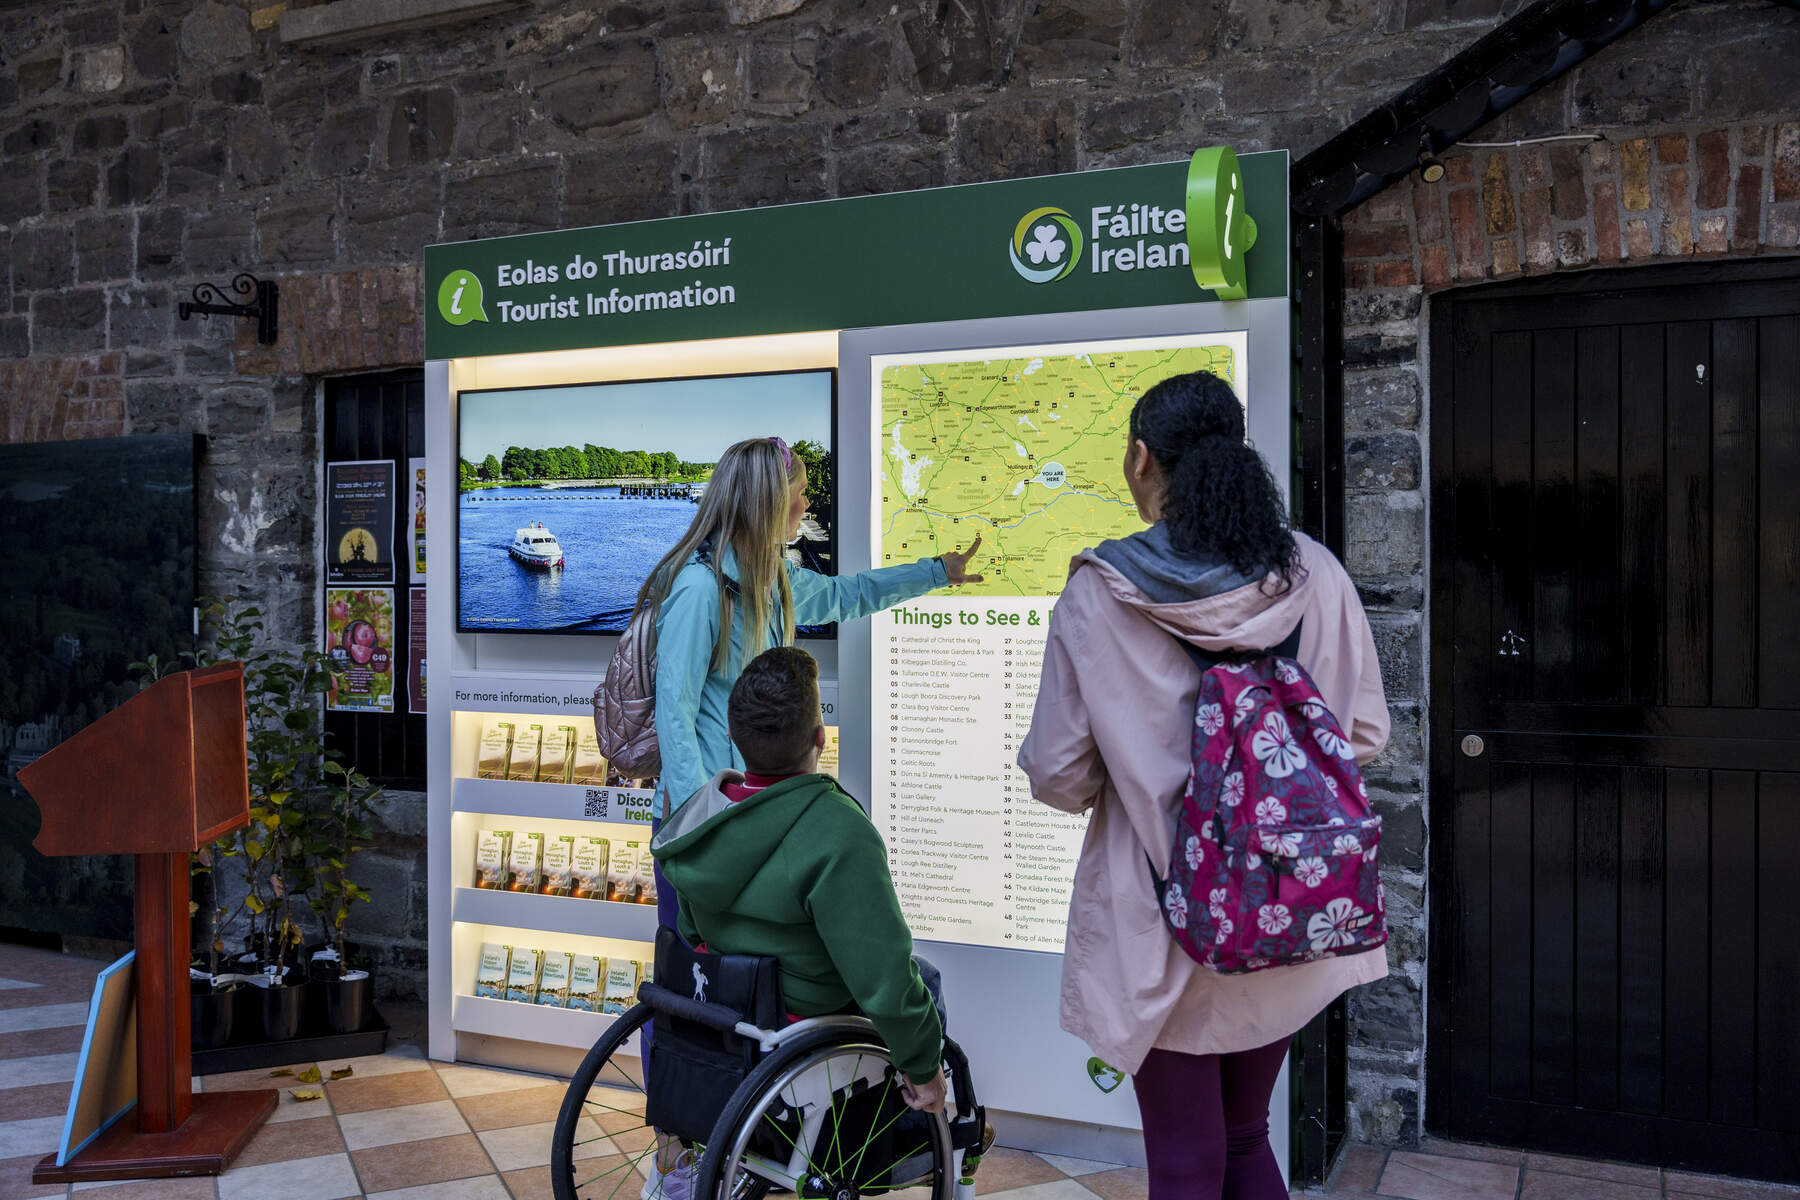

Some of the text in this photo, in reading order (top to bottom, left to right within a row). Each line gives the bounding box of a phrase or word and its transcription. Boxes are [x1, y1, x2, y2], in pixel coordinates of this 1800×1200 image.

[1091, 202, 1186, 239] Fáilte
[1091, 239, 1190, 273] Irelan
[497, 238, 732, 287] Eolas do Thurasóirí
[497, 280, 736, 323] Tourist Information
[891, 607, 1040, 629] Things to See &
[967, 637, 981, 645] King
[455, 690, 594, 707] For more information, please
[901, 692, 919, 700] Lough
[938, 693, 967, 701] Discovery
[901, 725, 924, 734] Clonony
[925, 726, 944, 734] Castle
[901, 737, 945, 745] Shannonbridge
[616, 793, 653, 807] Disco
[915, 793, 936, 802] Gallery
[624, 808, 653, 821] Irela
[949, 807, 974, 815] Heritage
[1028, 809, 1048, 817] Round
[918, 816, 944, 824] Uisneach
[1015, 820, 1050, 828] Castletown
[1051, 822, 1070, 830] House
[1015, 831, 1035, 840] Leixlip
[1035, 832, 1055, 840] Castle
[1015, 842, 1045, 851] Maynooth
[1046, 844, 1066, 852] Castle
[921, 850, 948, 859] Trackway
[901, 860, 919, 868] Lough
[932, 862, 957, 871] Distillery
[1015, 861, 1061, 871] Walled Garden
[918, 883, 950, 891] Edgeworth
[1028, 885, 1050, 893] Kildare
[901, 893, 923, 901] Knights
[936, 896, 967, 905] Conquests
[968, 899, 994, 908] Heritage
[1015, 895, 1050, 905] Newbridge
[1015, 903, 1036, 911] Centre
[1015, 934, 1029, 942] Bog
